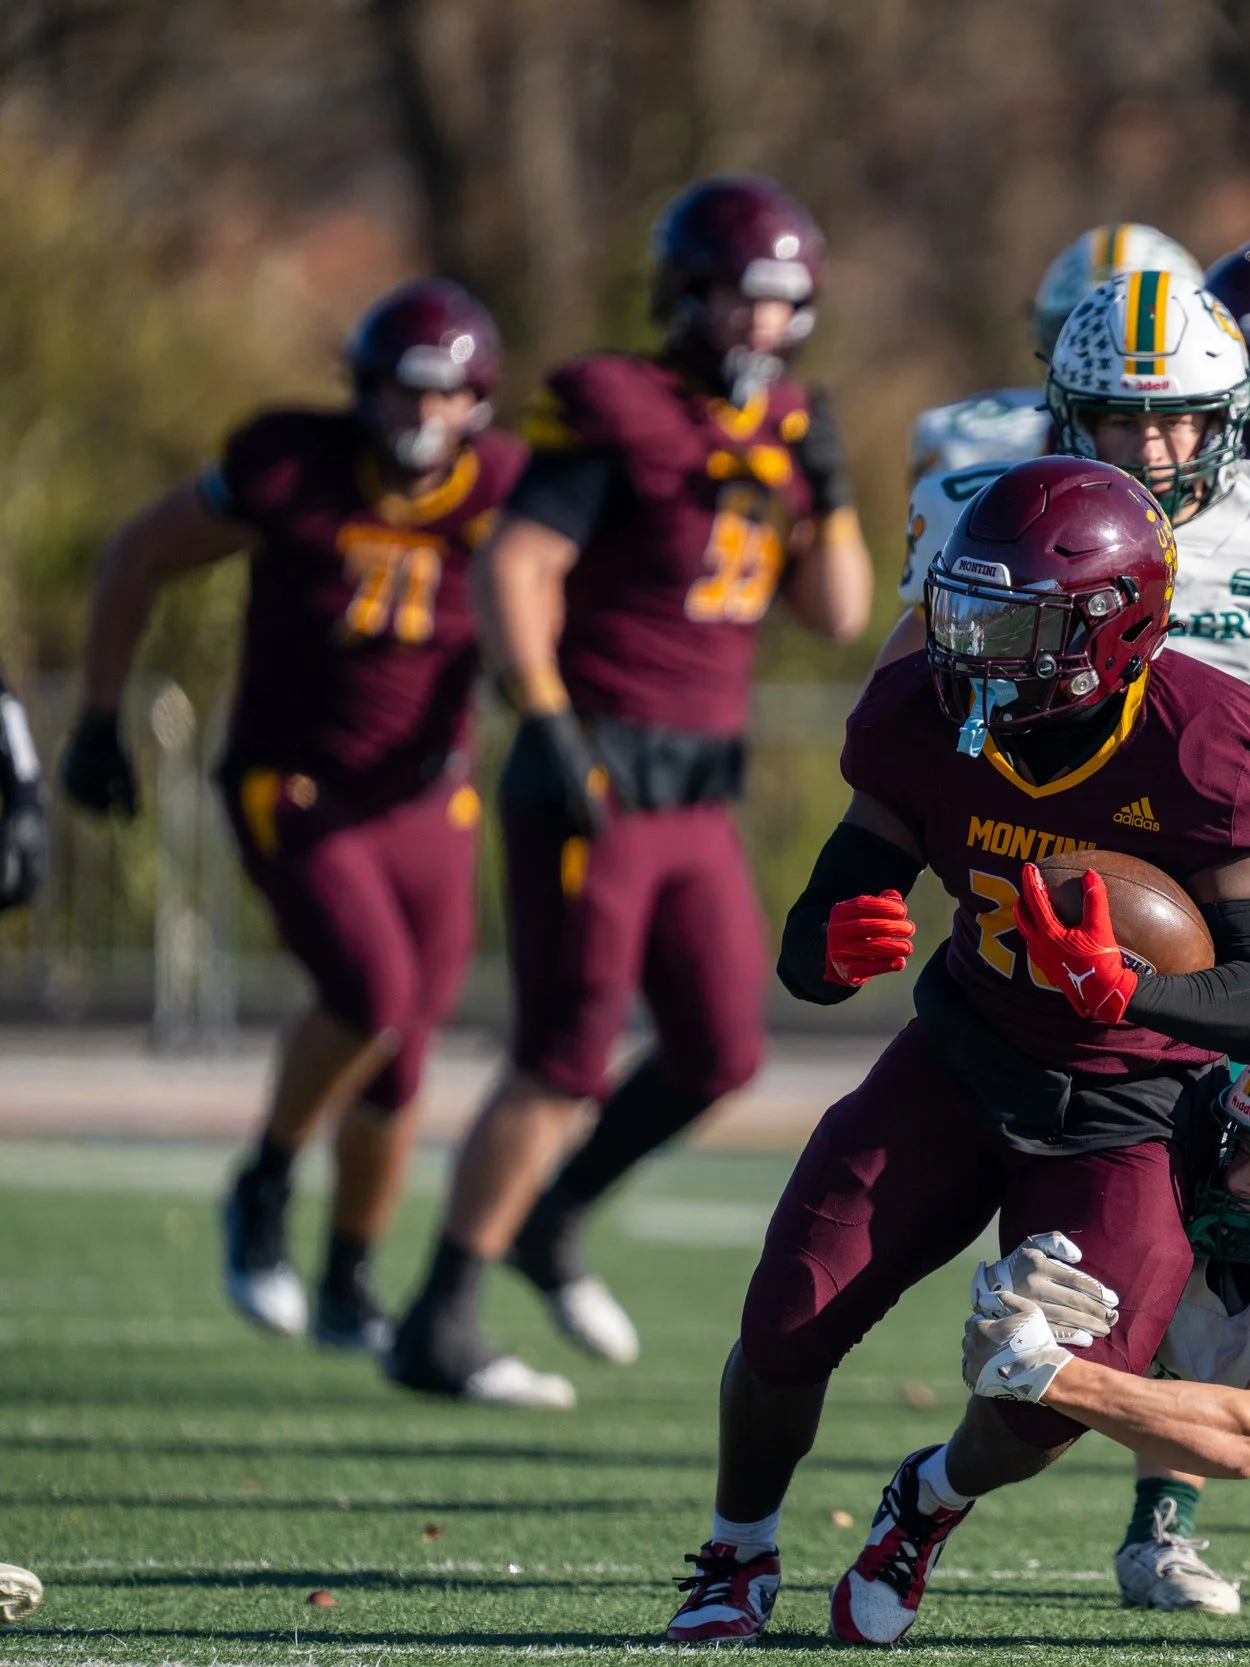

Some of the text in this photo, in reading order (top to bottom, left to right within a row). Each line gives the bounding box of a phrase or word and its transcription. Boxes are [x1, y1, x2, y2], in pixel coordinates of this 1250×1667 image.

[959, 560, 997, 577] MONTINI
[966, 815, 1097, 863] MONTI
[1113, 812, 1161, 832] adidas
[969, 868, 1063, 993] 2
